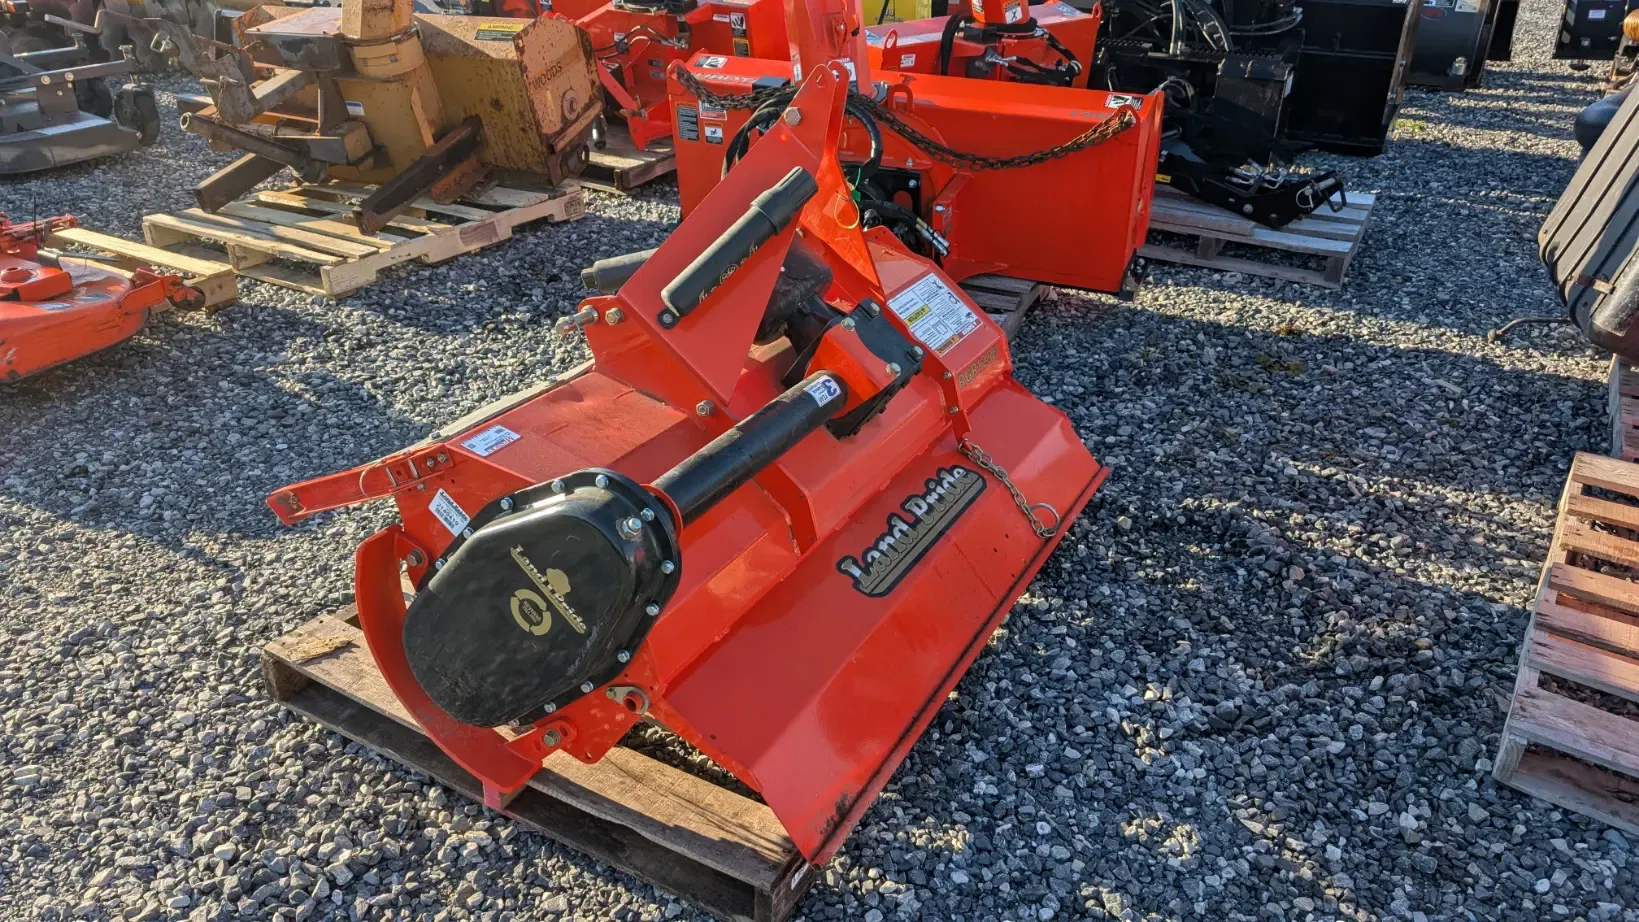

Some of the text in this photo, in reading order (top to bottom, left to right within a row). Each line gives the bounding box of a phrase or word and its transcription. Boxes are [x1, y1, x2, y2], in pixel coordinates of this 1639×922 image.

[534, 61, 563, 90] WOODS
[822, 379, 837, 397] 3
[841, 467, 974, 589] Land Pride
[513, 543, 587, 633] Land Pride
[522, 605, 538, 623] TILLING
[523, 600, 542, 620] REVERSE
